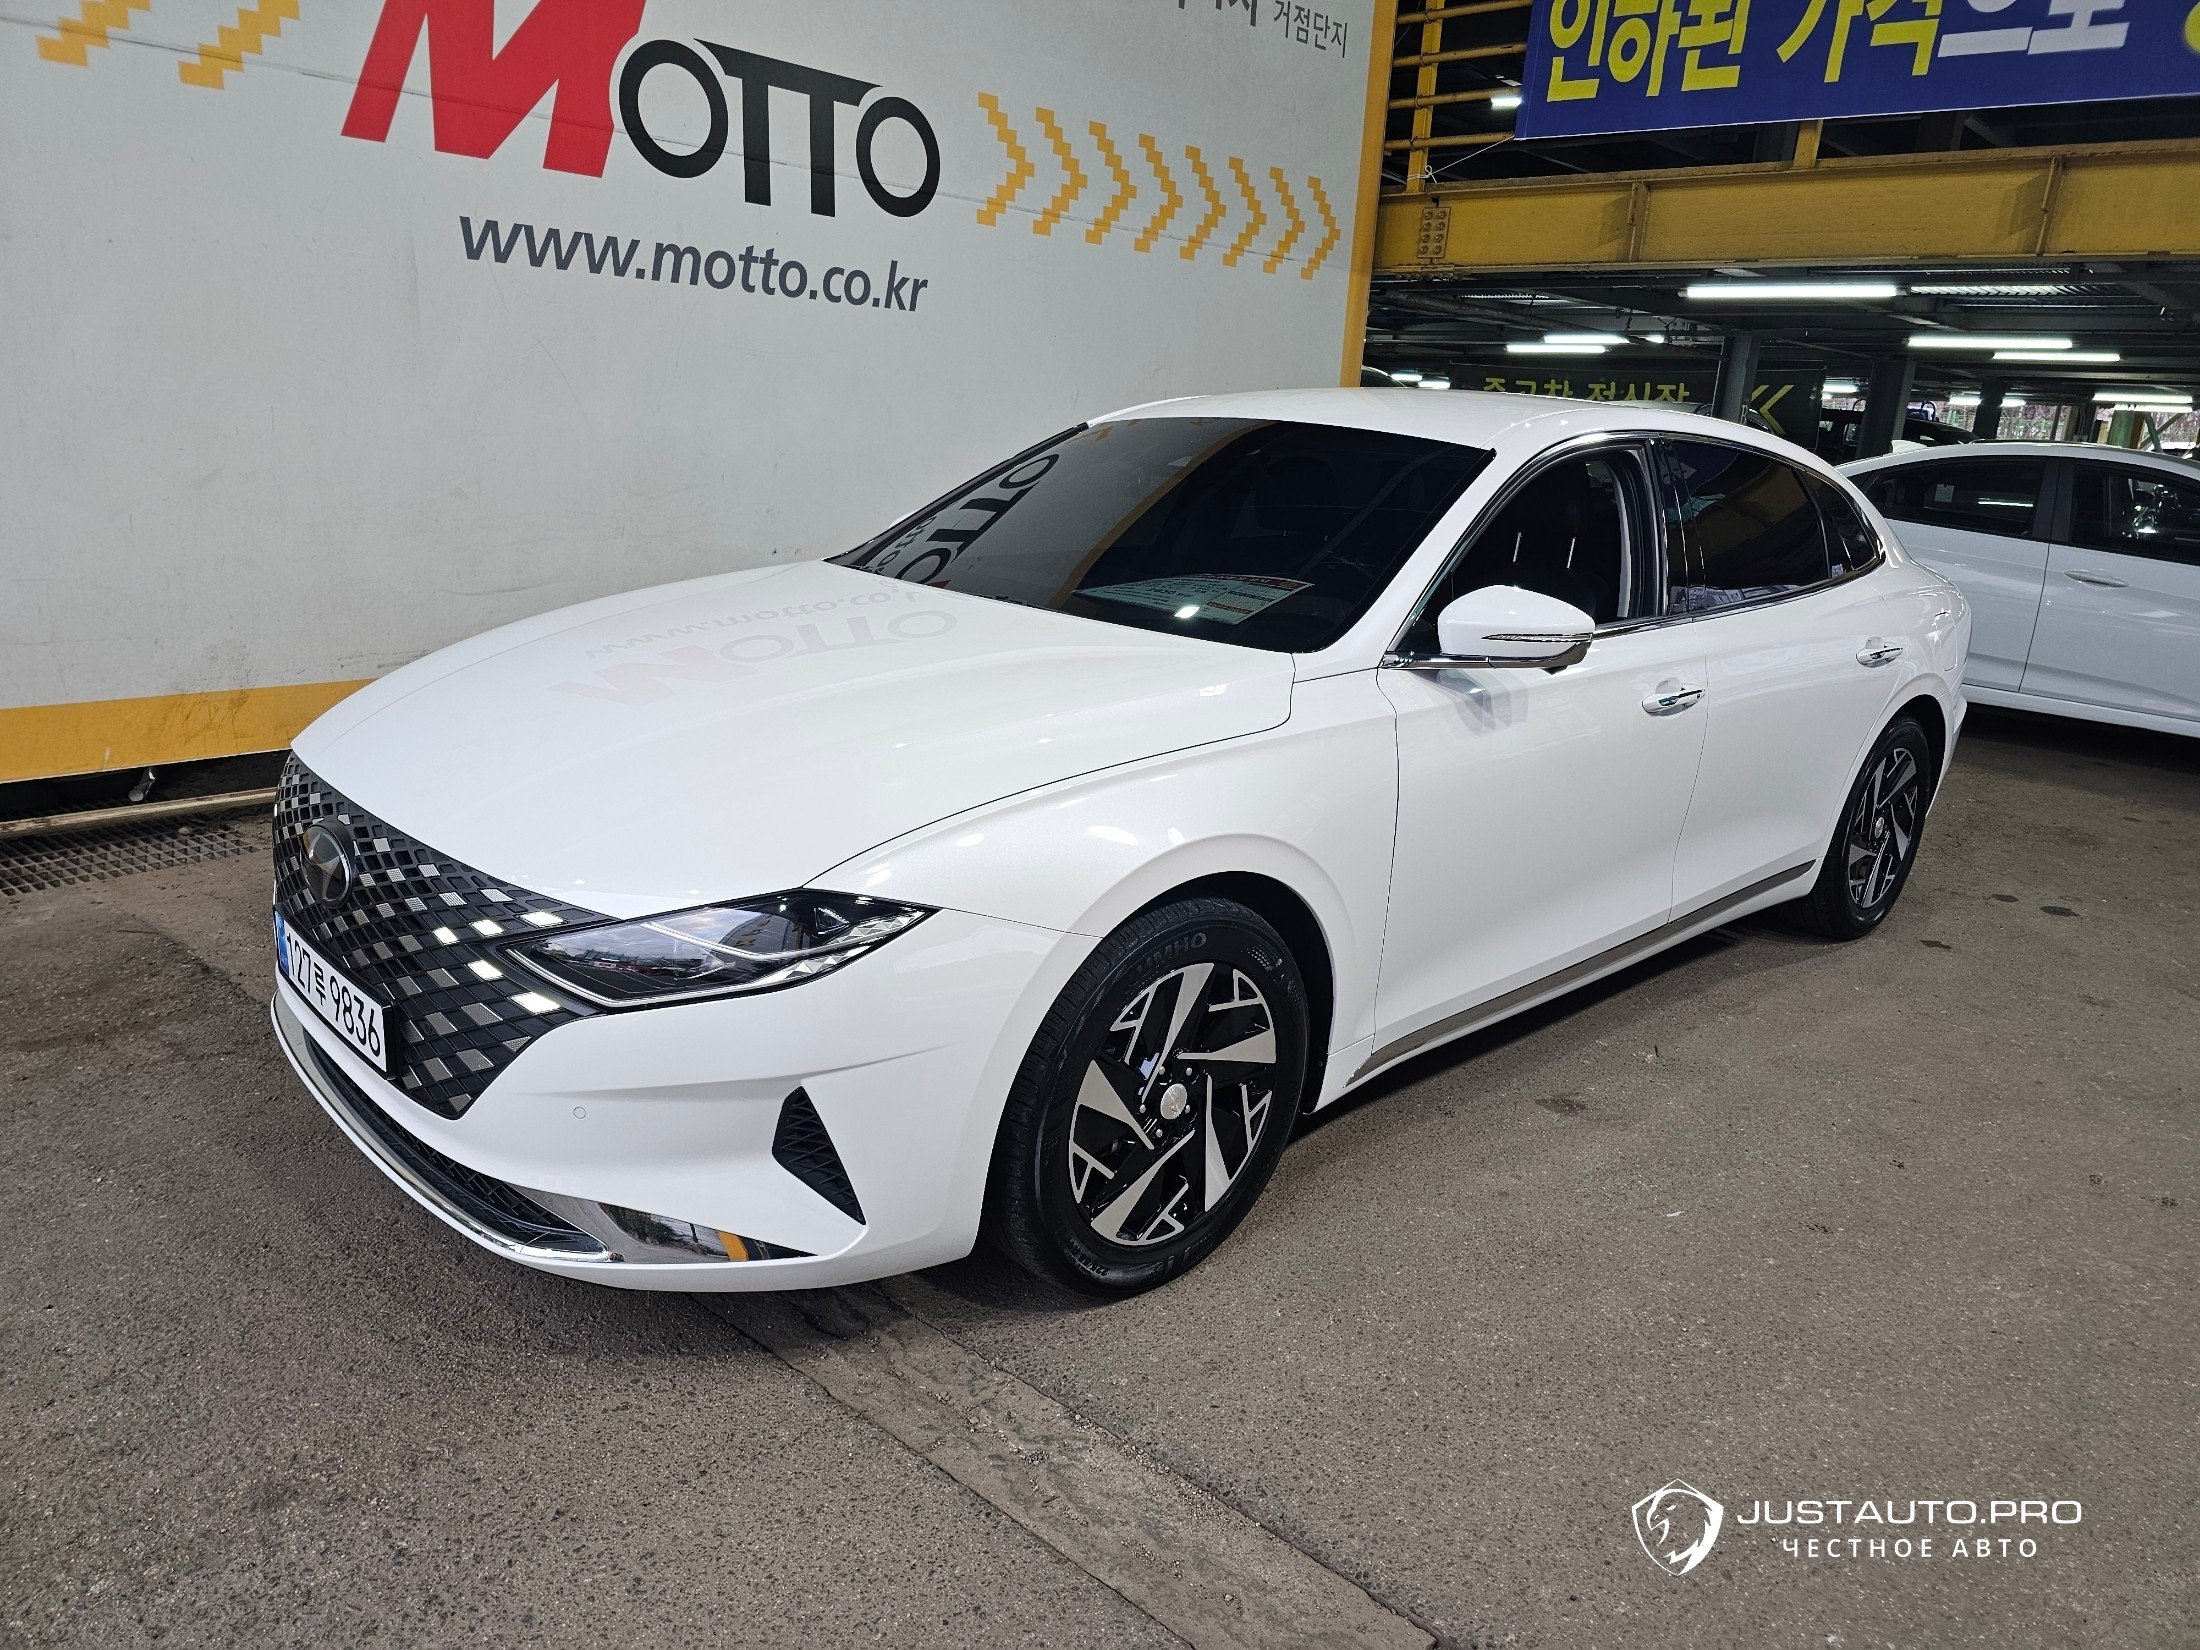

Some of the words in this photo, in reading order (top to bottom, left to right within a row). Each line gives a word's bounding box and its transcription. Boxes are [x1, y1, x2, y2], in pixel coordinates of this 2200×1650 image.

[1273, 0, 1348, 58] 거점단지
[340, 0, 940, 217] MOTTO
[459, 215, 929, 312] www.motto.co.kr
[286, 932, 326, 1007] 127루
[329, 975, 381, 1058] 9836
